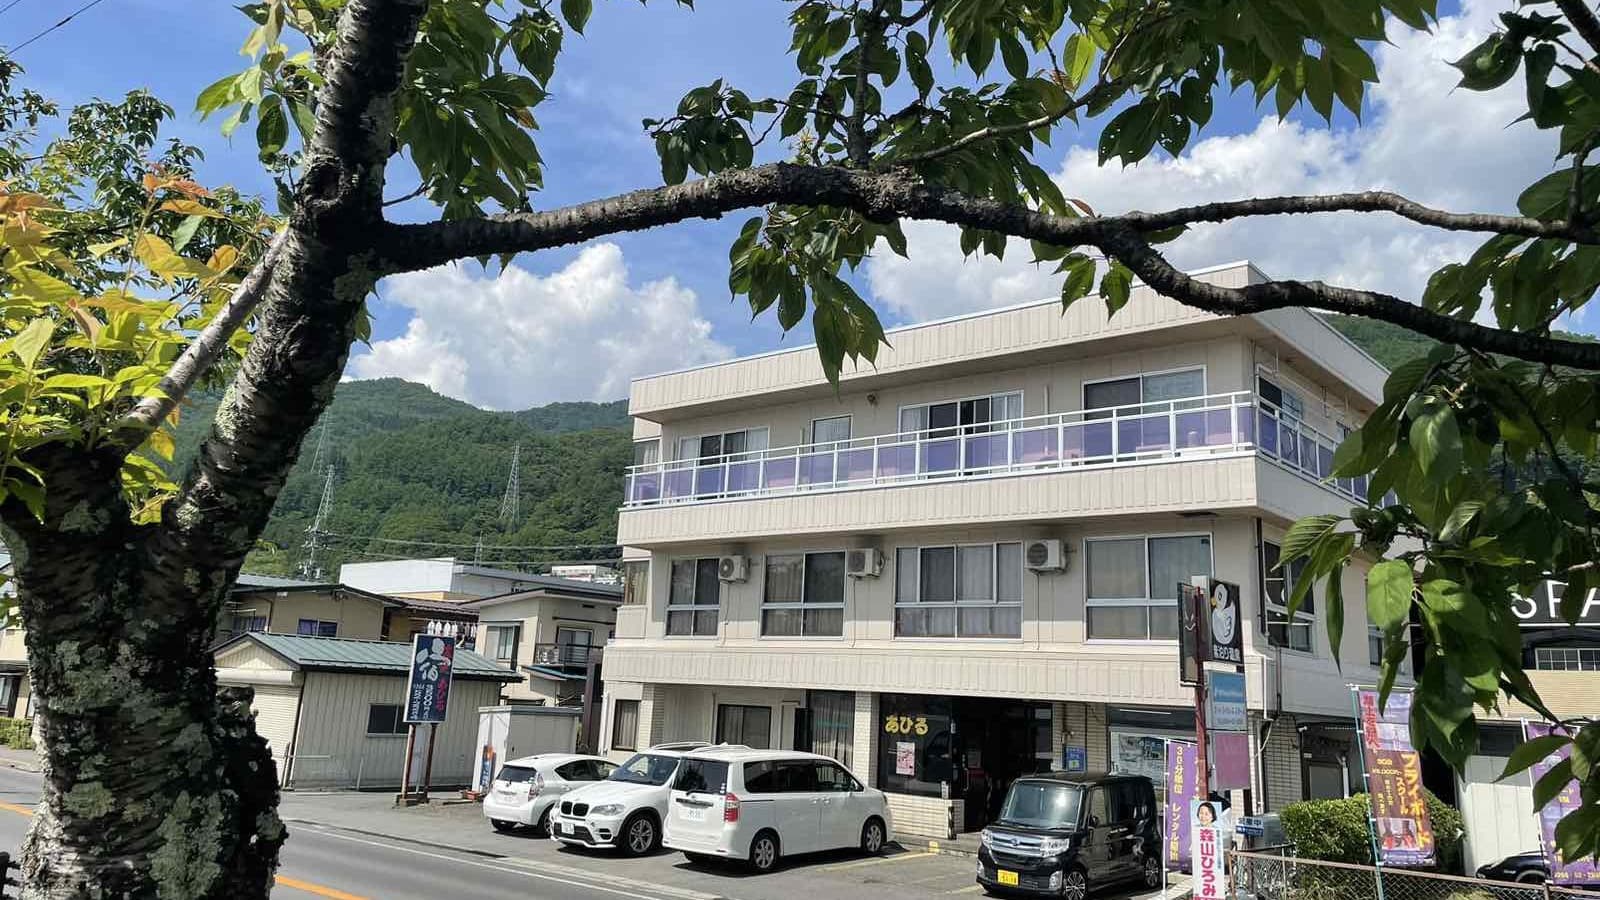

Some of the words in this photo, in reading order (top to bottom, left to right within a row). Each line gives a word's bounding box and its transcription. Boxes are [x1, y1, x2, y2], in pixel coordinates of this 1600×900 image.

[885, 715, 929, 735] あひる
[1400, 753, 1432, 848] フライボード
[1199, 828, 1217, 897] 森山ひろみ
